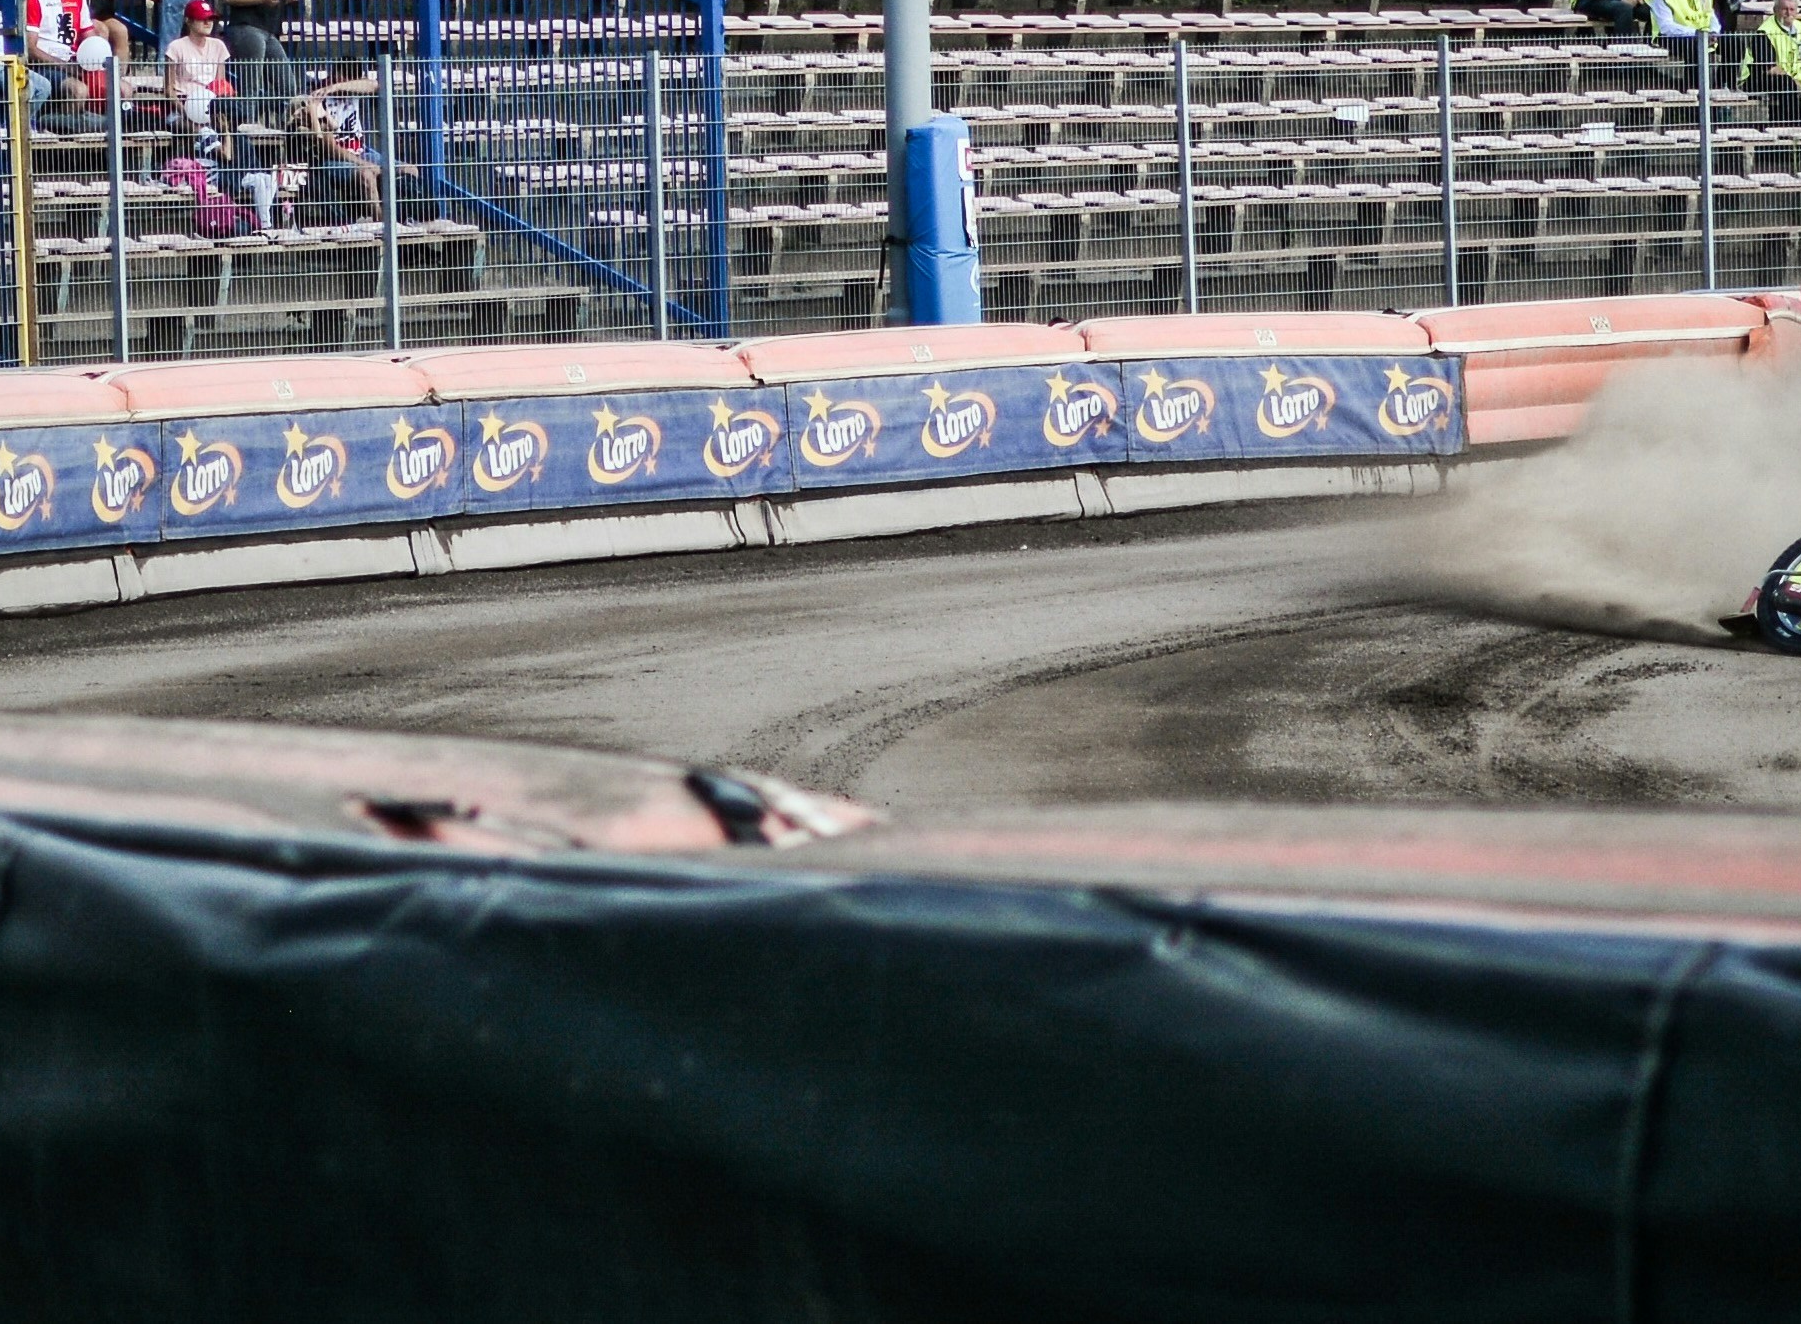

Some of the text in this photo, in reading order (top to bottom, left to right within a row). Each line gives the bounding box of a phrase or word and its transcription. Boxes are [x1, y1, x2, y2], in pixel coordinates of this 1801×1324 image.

[936, 404, 981, 446] LOTTO
[1056, 392, 1102, 434] LOTTO
[1151, 391, 1200, 431] LOTTO
[1275, 387, 1320, 429] LOTTO
[1395, 385, 1439, 427] LOTTO
[489, 433, 533, 477] LOTTO
[602, 427, 647, 470] LOTTO
[717, 423, 763, 466] LOTTO
[817, 412, 866, 455] LOTTO
[186, 455, 228, 500] LOTTO
[291, 448, 333, 493] LOTTO
[400, 440, 441, 485] LOTTO
[1, 468, 42, 515] LOTTO
[106, 463, 141, 507] LOTTO
